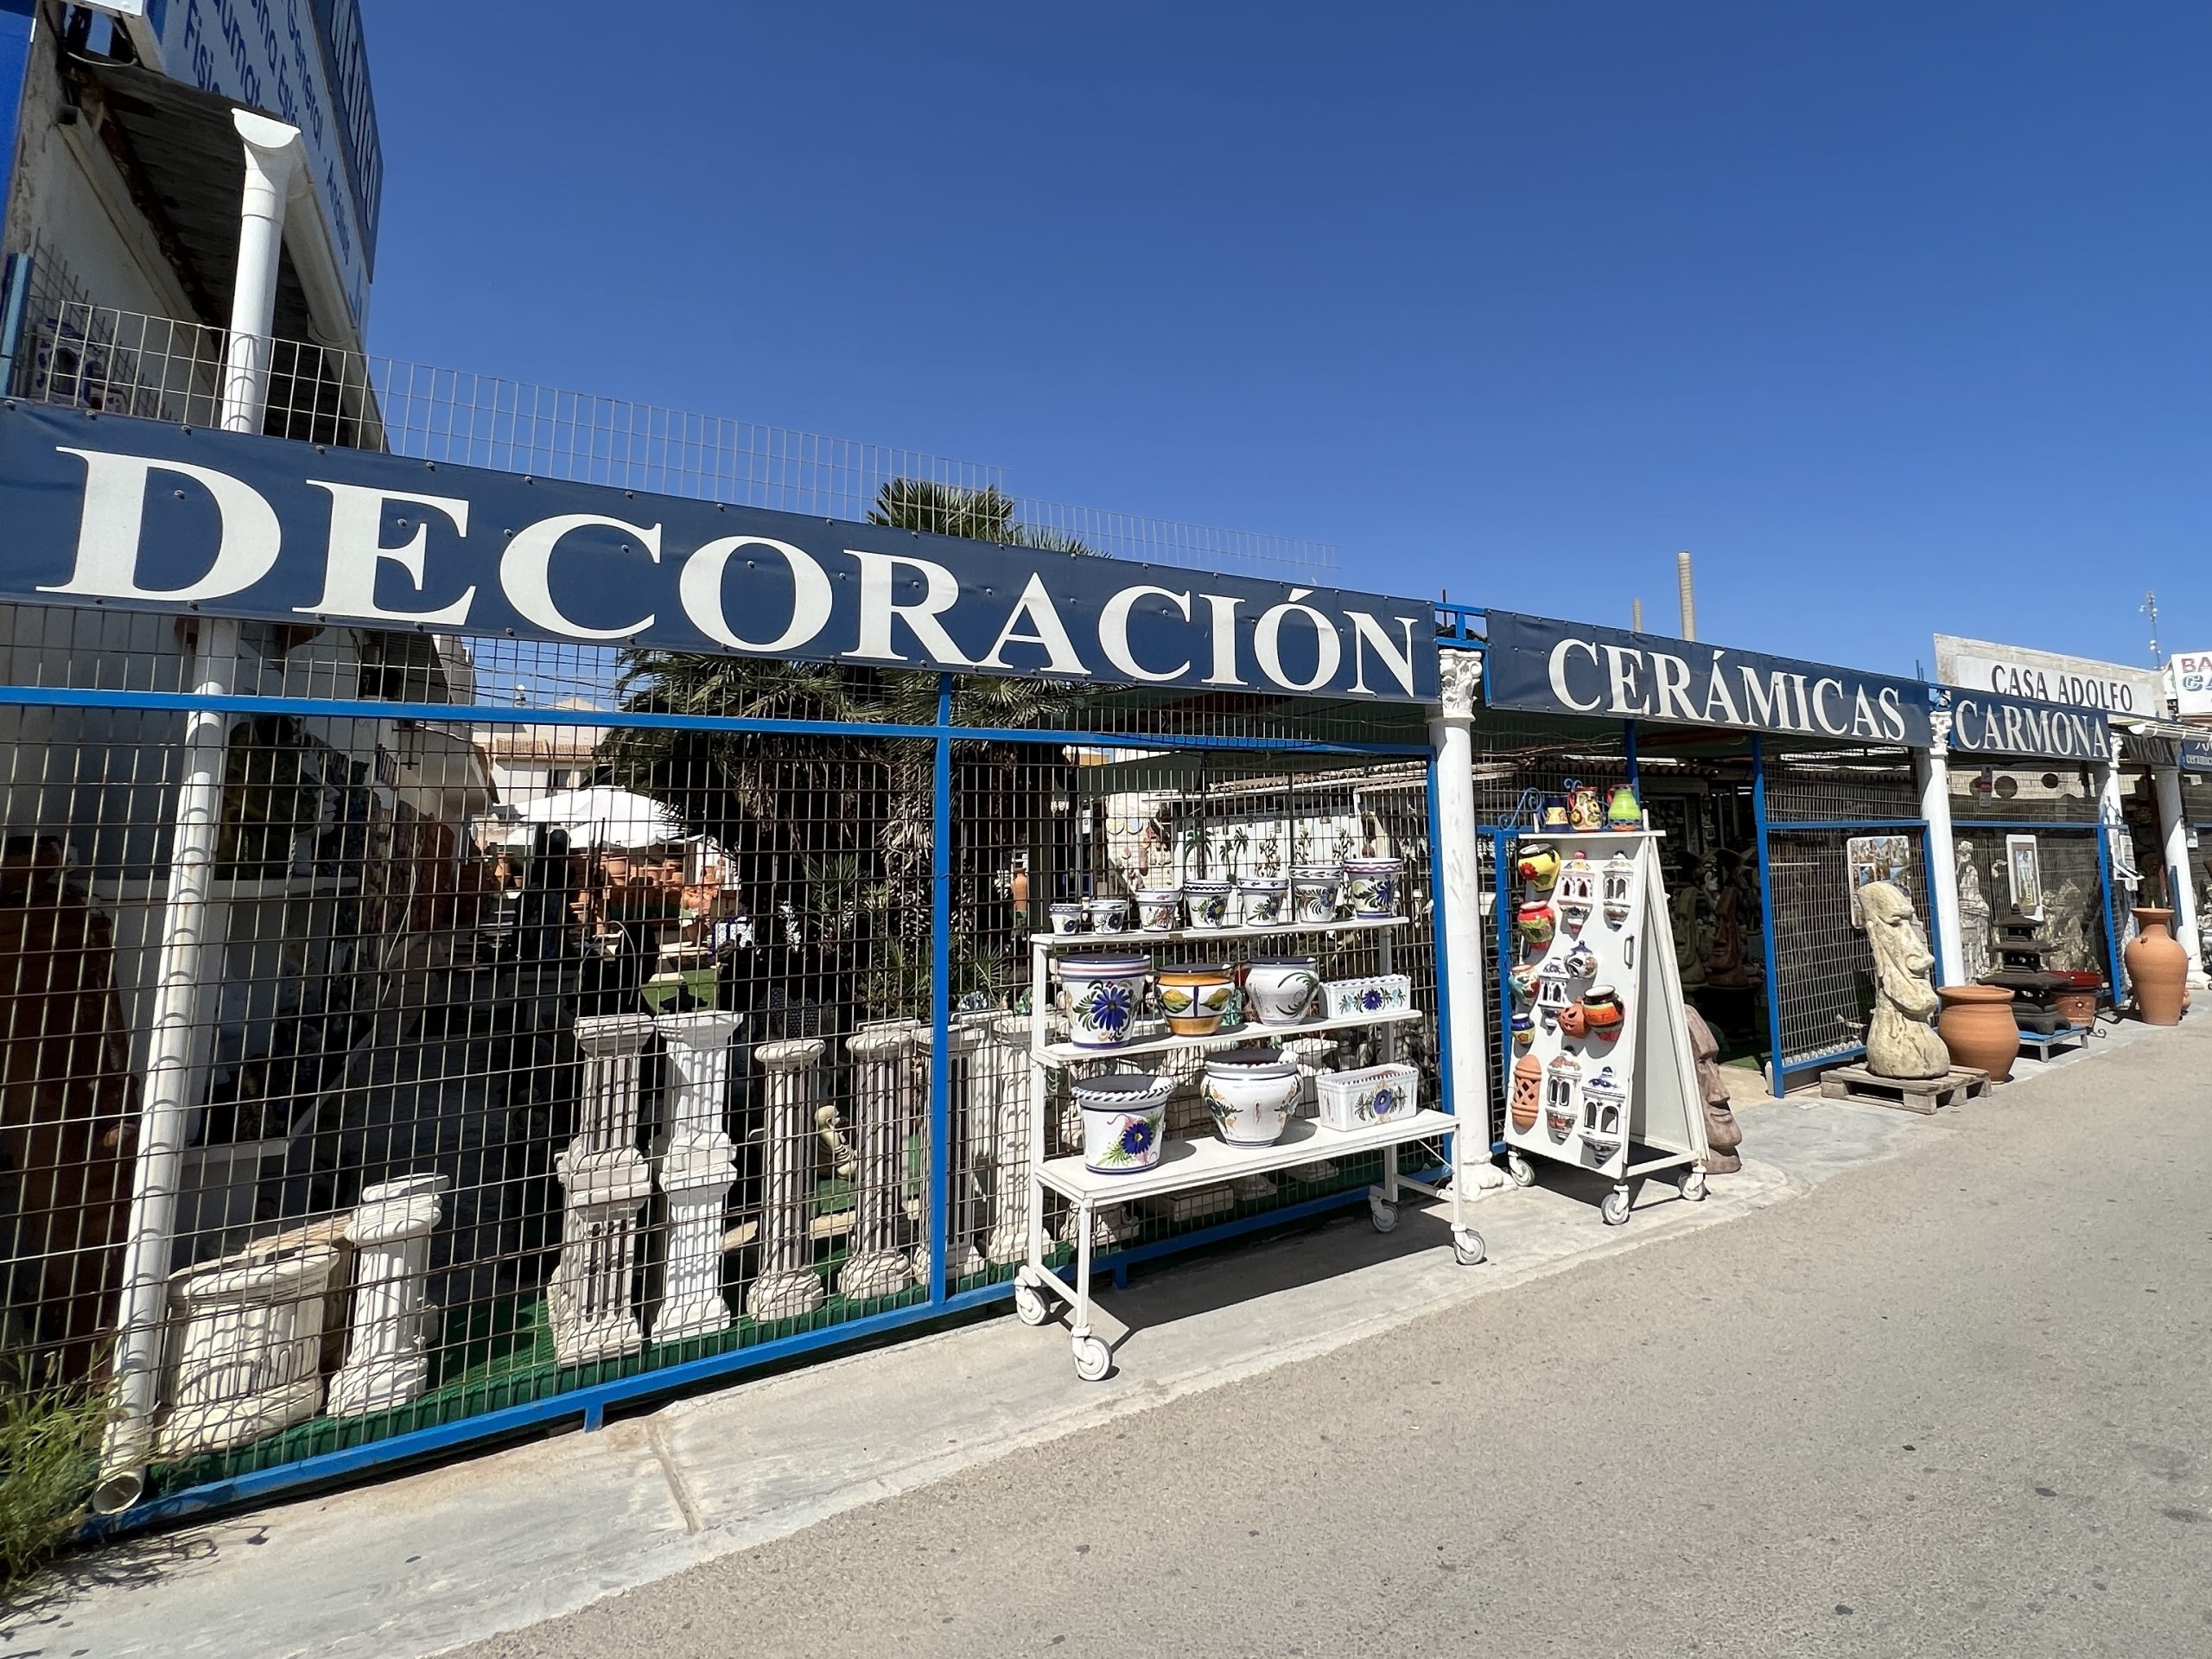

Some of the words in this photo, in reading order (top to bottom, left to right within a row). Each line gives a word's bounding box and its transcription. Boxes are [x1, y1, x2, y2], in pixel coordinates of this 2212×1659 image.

[213, 0, 266, 110] umat
[251, 0, 277, 76] ina
[35, 446, 1419, 698] DECORACIÓN
[1548, 638, 1906, 741] CERÁMICAS
[1955, 700, 2111, 759] CARMONA
[1991, 664, 2050, 702] CASA
[2058, 675, 2133, 712] ADOLFO
